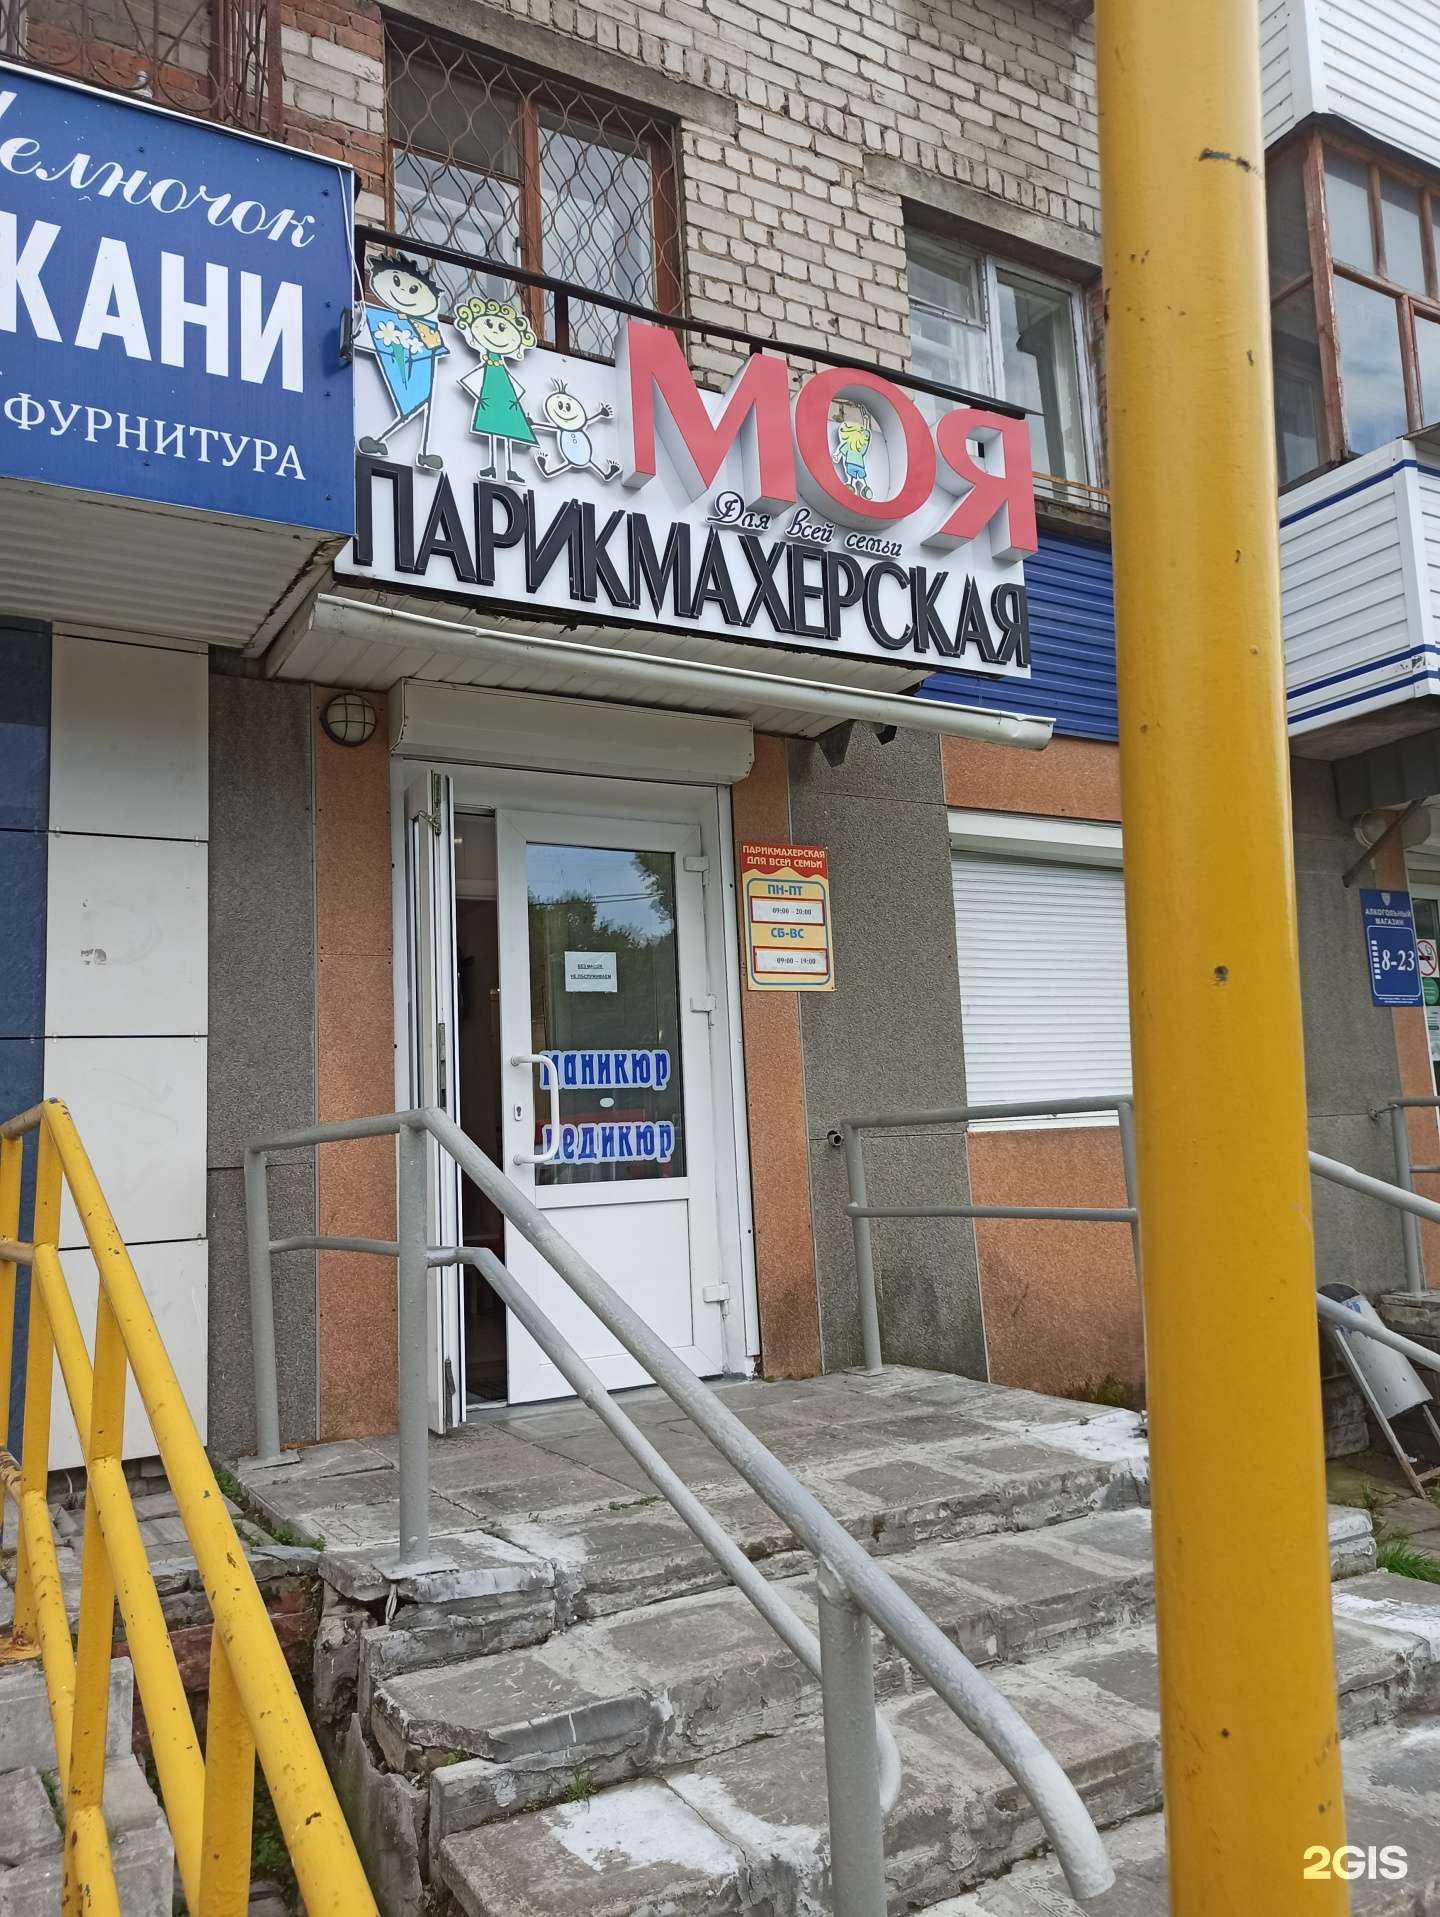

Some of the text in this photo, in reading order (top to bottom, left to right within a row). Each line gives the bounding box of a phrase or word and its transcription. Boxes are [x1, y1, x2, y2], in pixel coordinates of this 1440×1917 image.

[0, 91, 317, 248] елночок
[3, 392, 307, 480] ФУРНИТУРА
[622, 320, 1039, 562] МОЯ
[707, 490, 771, 530] Для
[846, 533, 903, 558] семьи
[353, 456, 1030, 668] ПАРИКМАХЕРСКАЯ
[743, 845, 825, 859] ПАРИКМАХЕРСКАЯ
[747, 857, 823, 869] ДЛЯ ВСЕЙ СЕМЬИ
[767, 884, 803, 896] ПН-ПТ
[770, 927, 805, 939] СБ-ВС
[1381, 949, 1415, 972] 8-23
